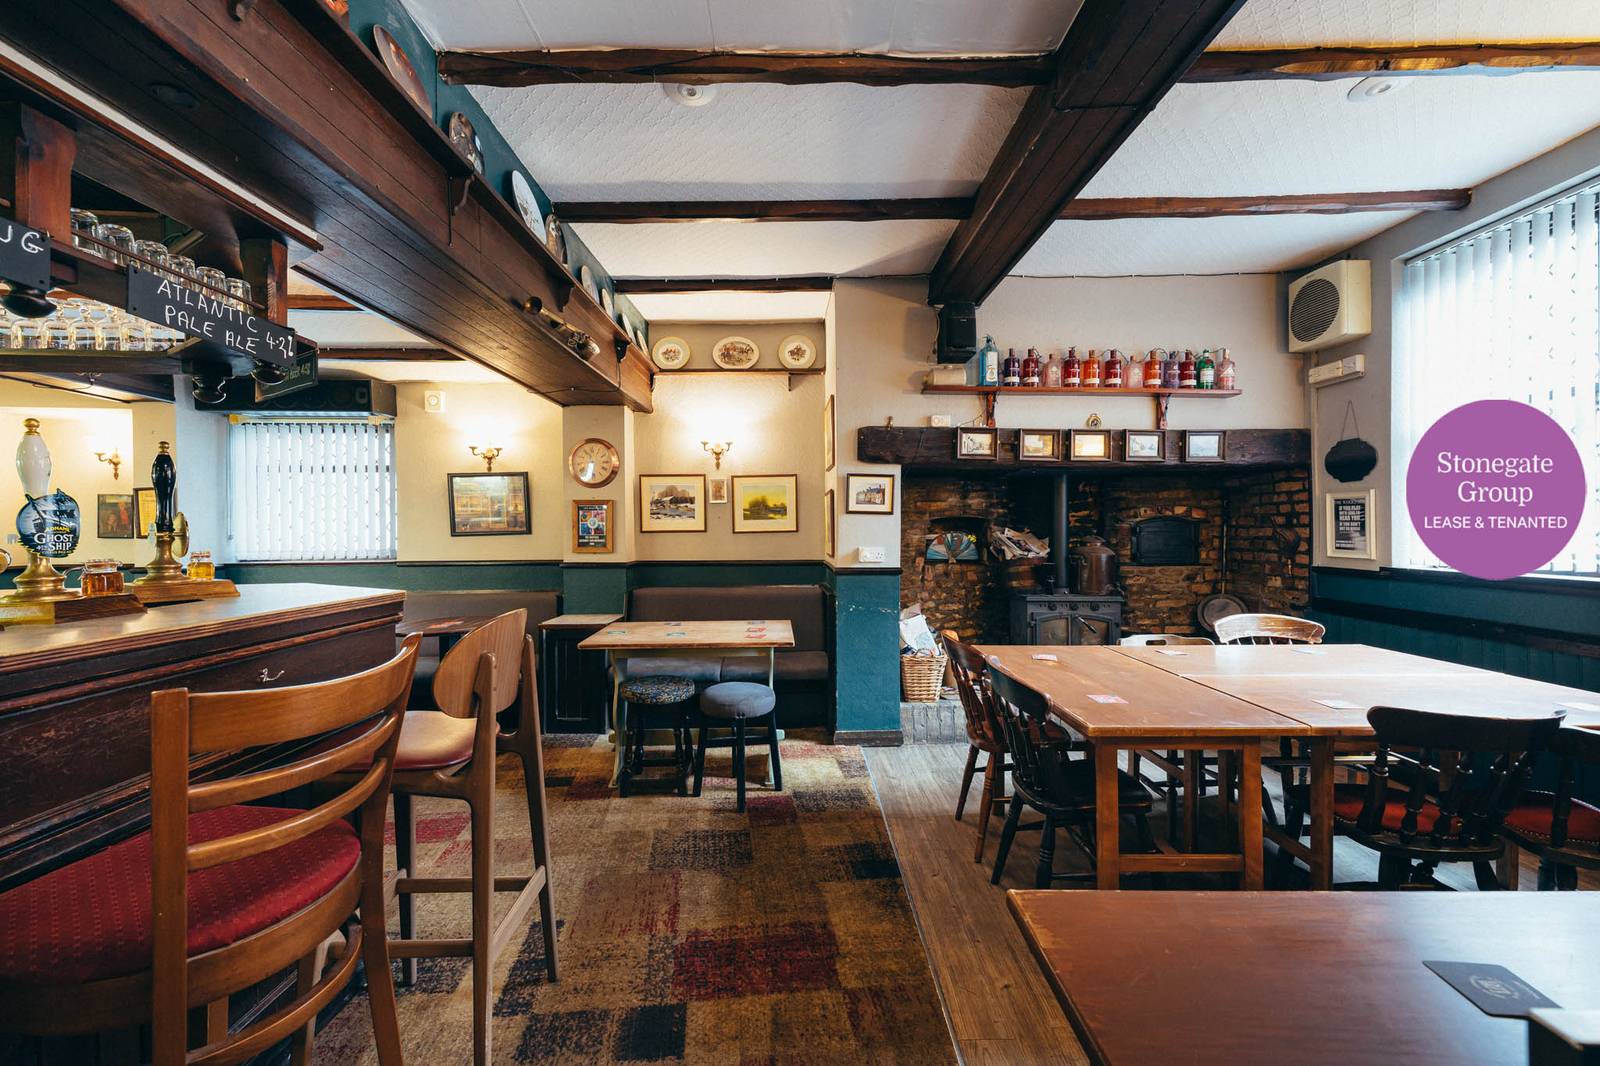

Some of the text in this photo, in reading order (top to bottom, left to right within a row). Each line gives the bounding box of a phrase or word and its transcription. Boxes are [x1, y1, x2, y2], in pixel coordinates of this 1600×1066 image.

[157, 279, 257, 333] ATLANTIC
[164, 304, 215, 338] PALE
[225, 330, 260, 354] ALE
[33, 532, 74, 545] GHOST
[48, 541, 72, 551] SHIP
